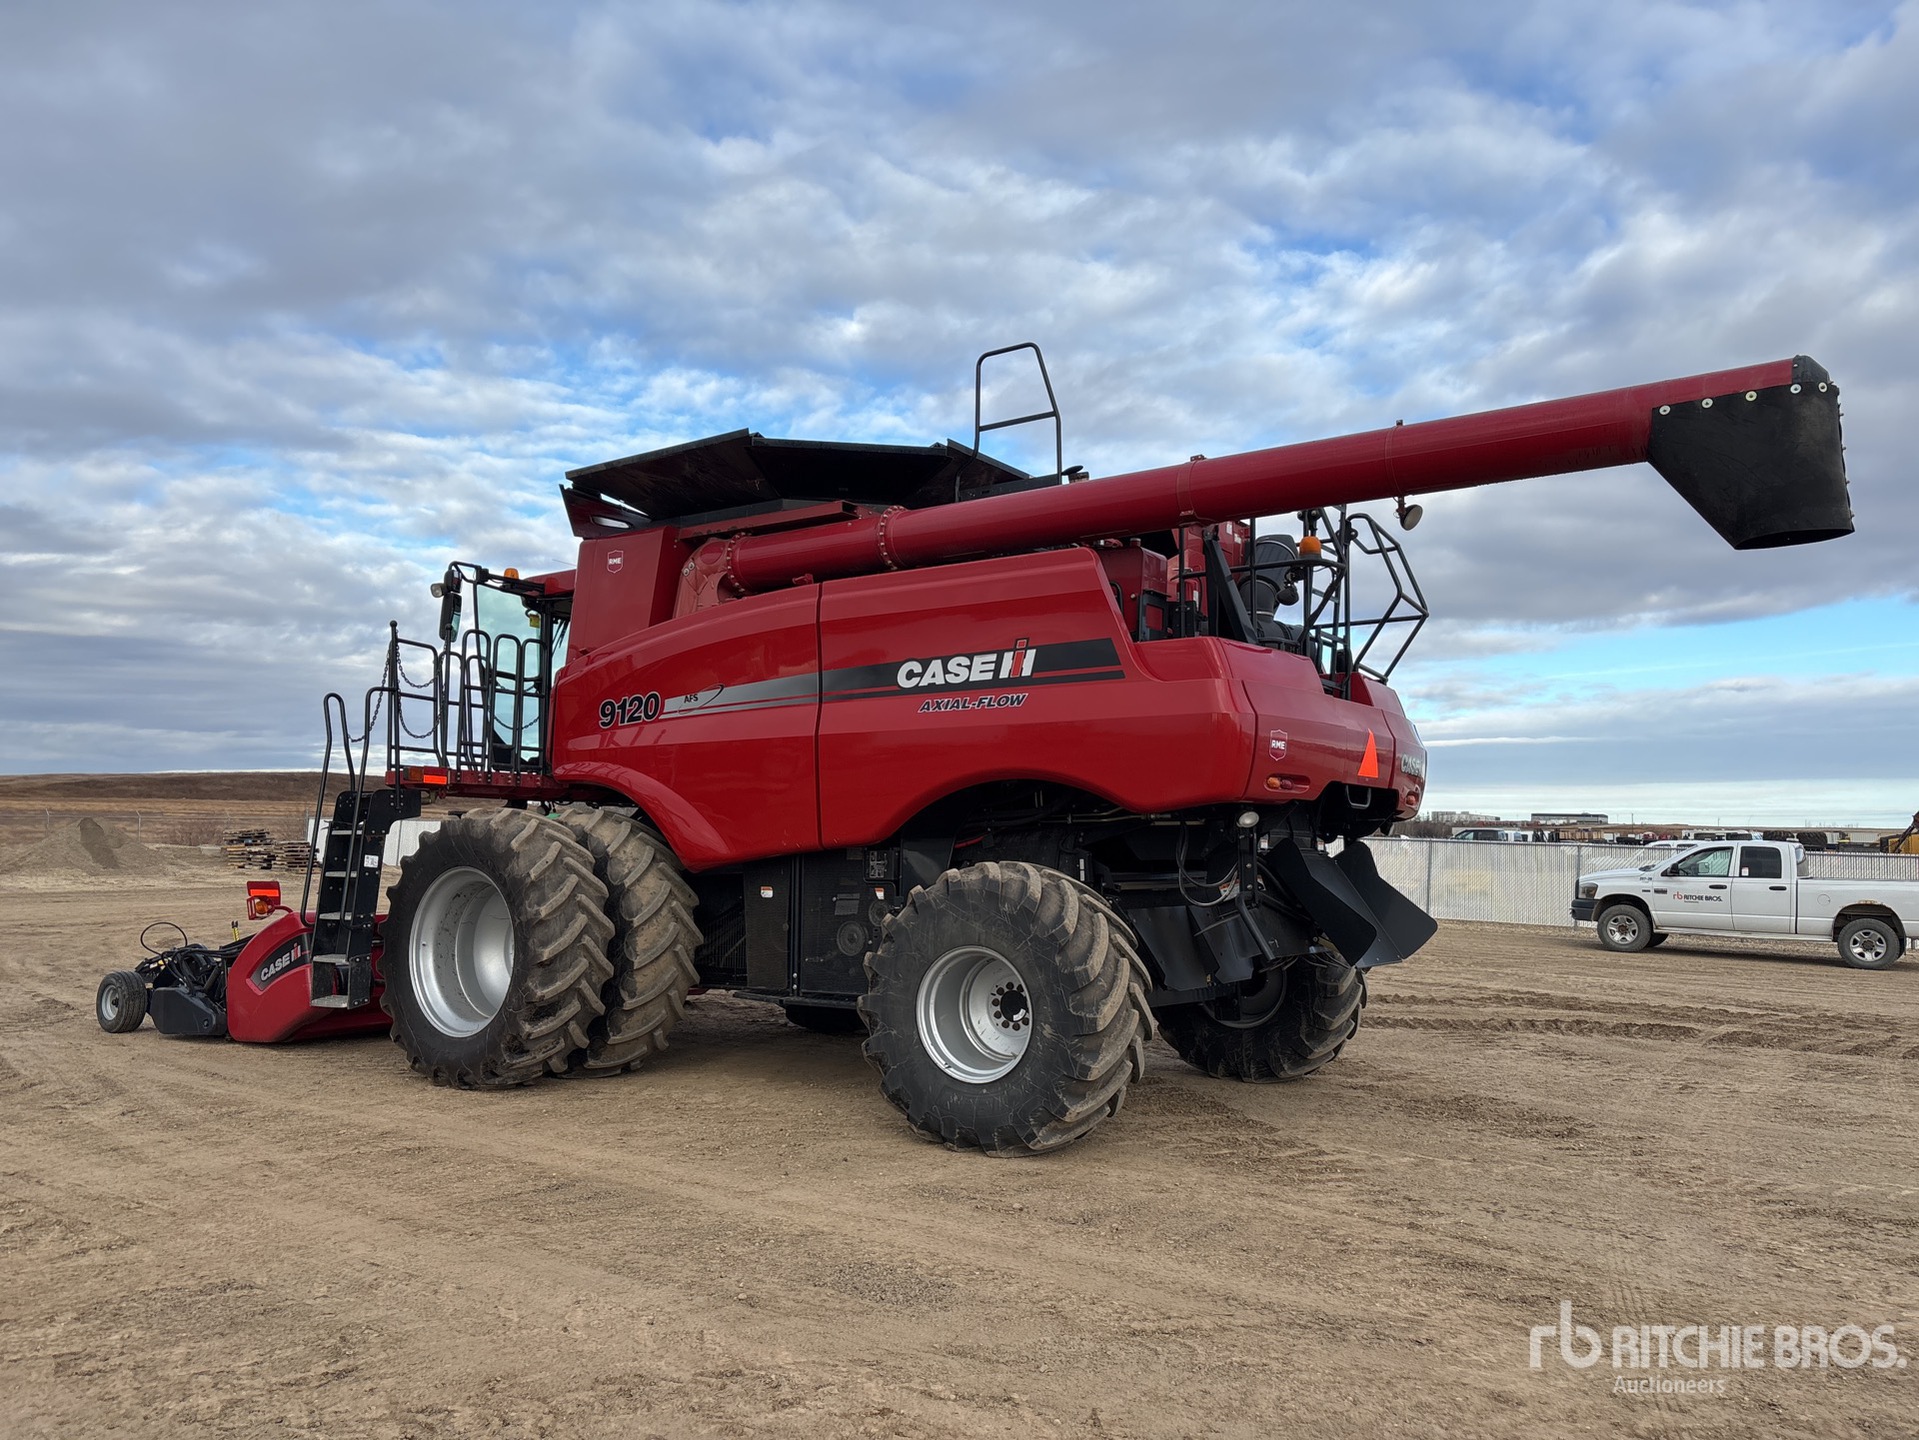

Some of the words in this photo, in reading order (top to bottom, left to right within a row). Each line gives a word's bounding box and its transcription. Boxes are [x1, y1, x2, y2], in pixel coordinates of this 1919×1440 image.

[896, 652, 998, 689] CASE
[599, 691, 660, 728] 9120
[683, 693, 699, 704] AFS
[917, 692, 1029, 713] AXIAL-FLOW
[1271, 739, 1286, 750] RME
[260, 952, 291, 981] CASE
